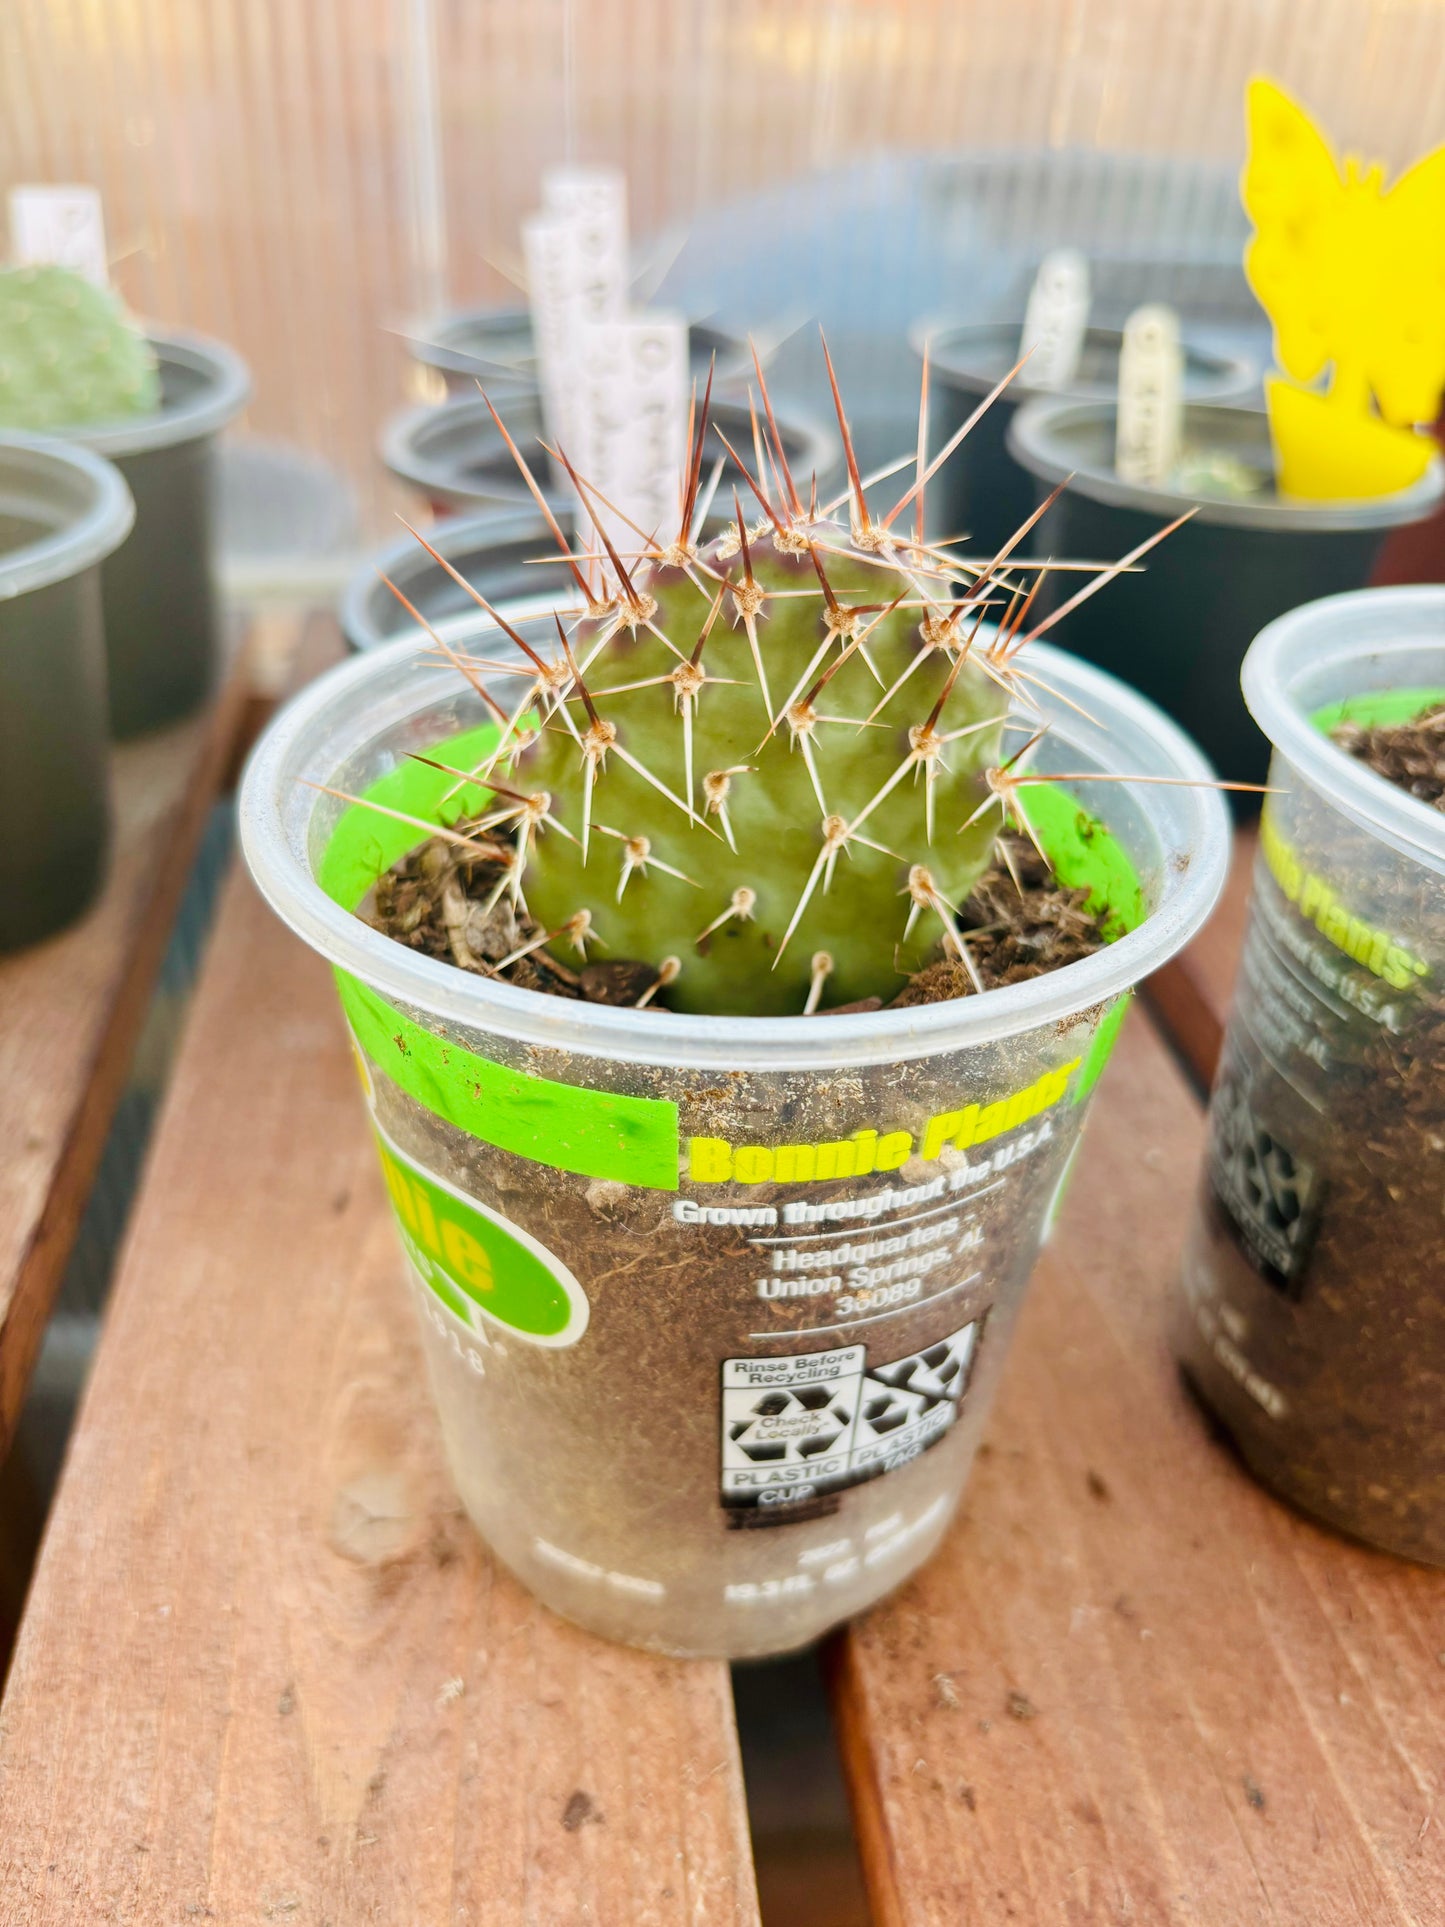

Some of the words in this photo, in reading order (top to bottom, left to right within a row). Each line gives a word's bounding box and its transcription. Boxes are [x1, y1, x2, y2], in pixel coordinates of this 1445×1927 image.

[689, 1129, 913, 1184] Bonnie
[673, 1199, 778, 1226] Grown
[783, 1174, 945, 1225] throughout
[950, 1160, 992, 1191] the
[772, 1216, 959, 1271] Headquarters
[756, 1275, 842, 1299] Union
[848, 1246, 952, 1289] Springs,
[733, 1362, 788, 1373] Rinse
[795, 1352, 855, 1369] Before
[749, 1365, 841, 1384] Recycling
[761, 1413, 821, 1428] Check
[859, 1410, 946, 1464] PLASTIC
[733, 1459, 839, 1486] PLASTIC
[757, 1485, 816, 1504] CUP
